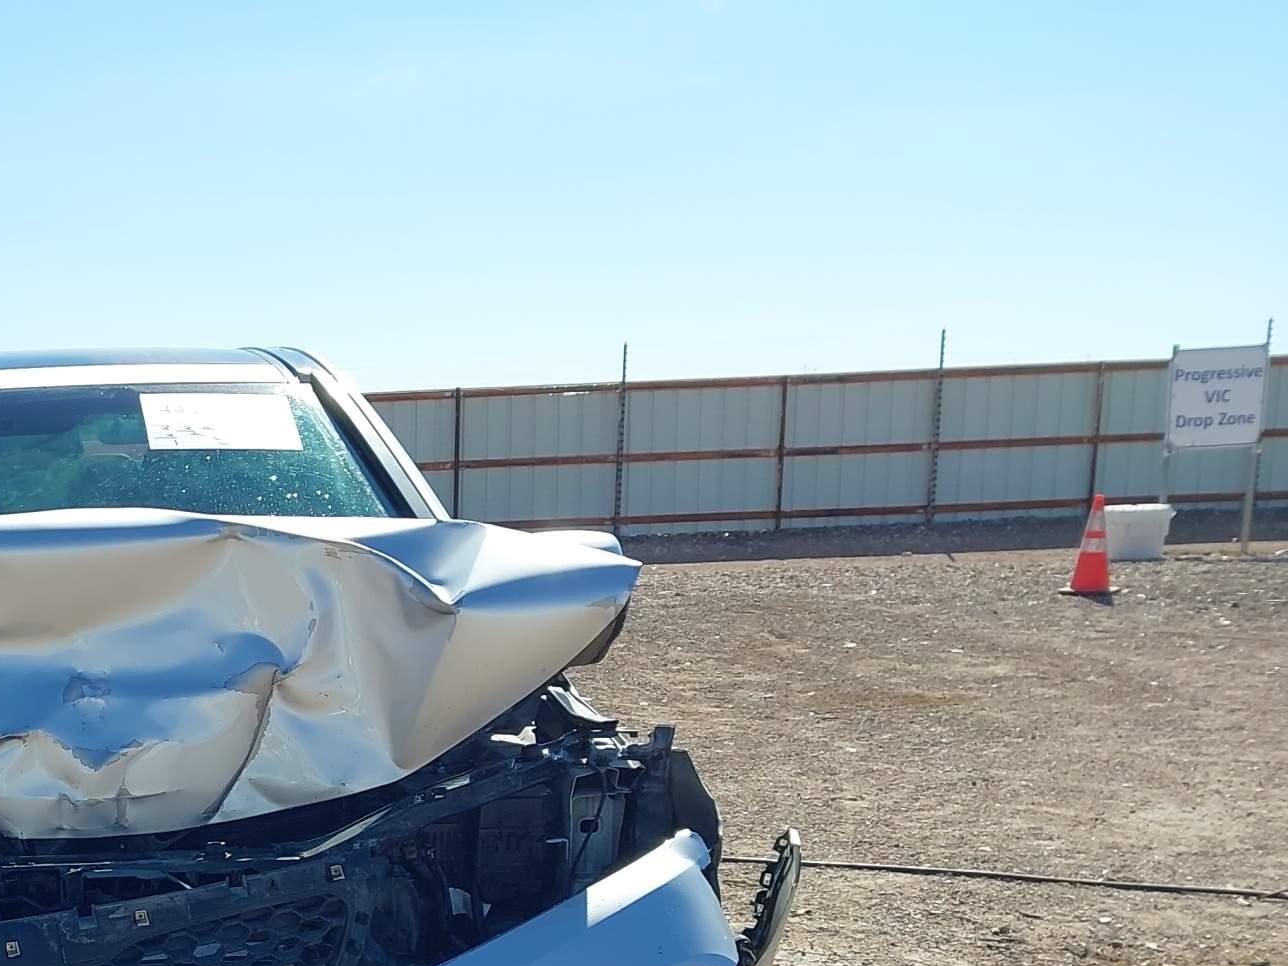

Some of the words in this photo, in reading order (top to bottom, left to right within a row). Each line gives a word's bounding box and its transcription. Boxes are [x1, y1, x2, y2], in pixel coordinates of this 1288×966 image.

[1174, 364, 1263, 384] Progressive
[1204, 389, 1231, 403] VIC
[1175, 414, 1213, 429] Drop
[1218, 413, 1256, 426] Zone
